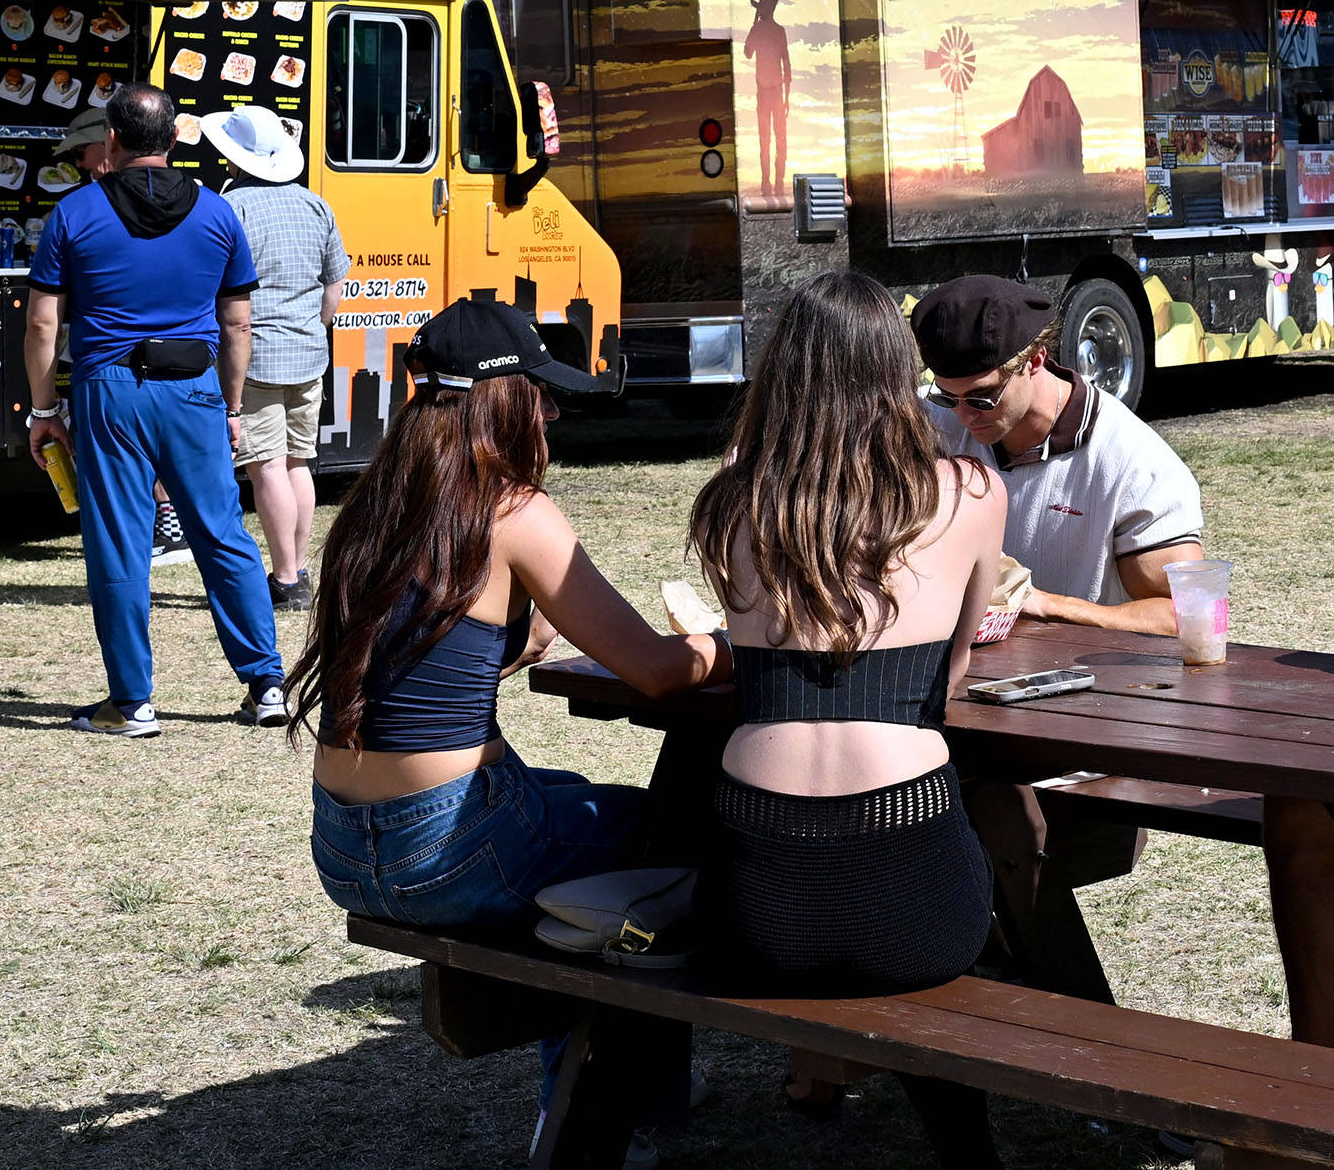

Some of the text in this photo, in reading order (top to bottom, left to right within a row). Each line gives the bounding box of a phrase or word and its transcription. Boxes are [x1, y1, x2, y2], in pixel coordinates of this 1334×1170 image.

[1184, 64, 1212, 81] WISE
[532, 210, 560, 234] Deli
[357, 253, 431, 267] A HOUSE CALL
[343, 278, 427, 299] 10-321-8714
[478, 354, 520, 370] aramco
